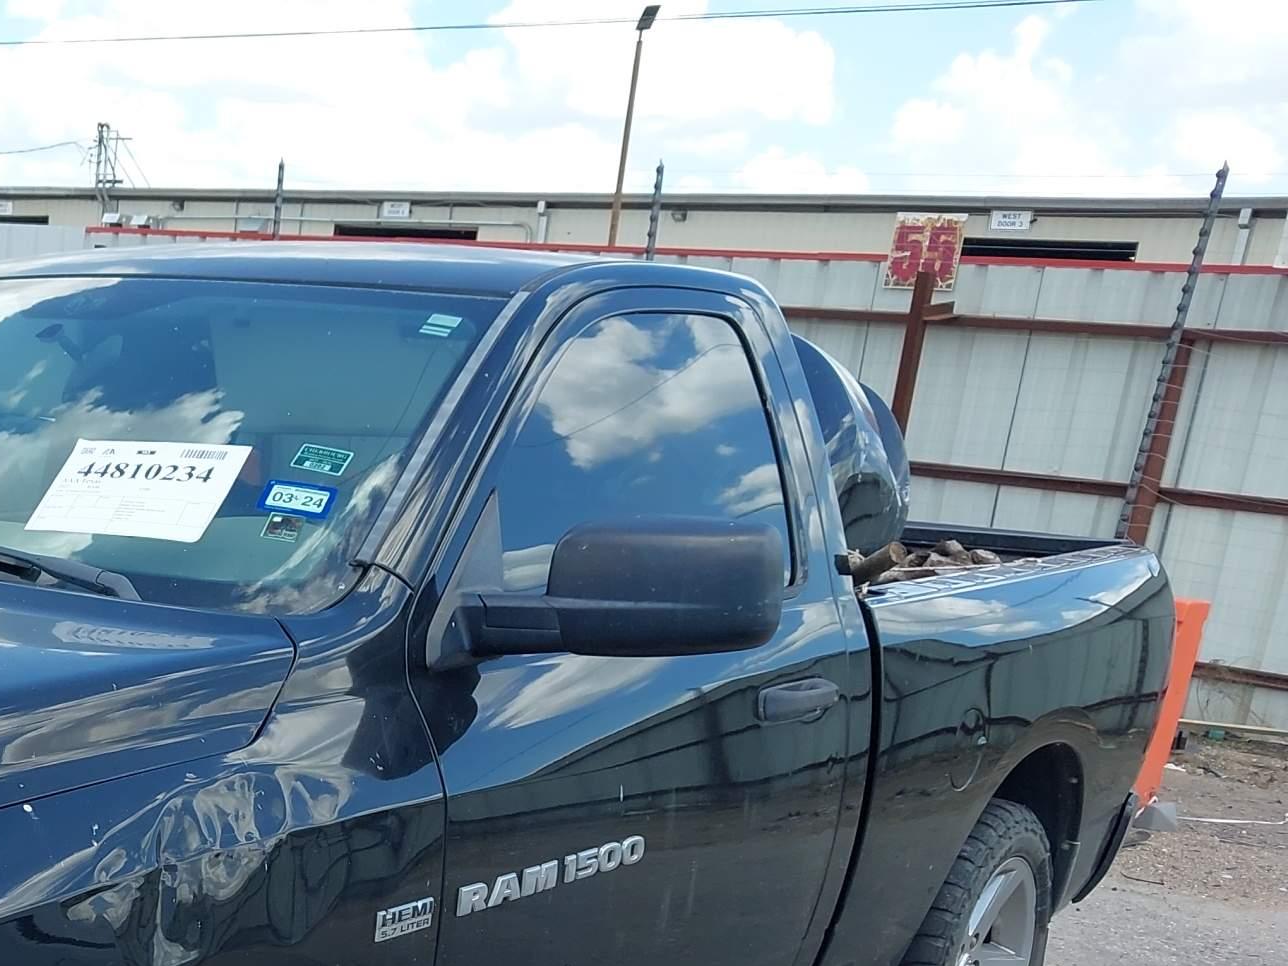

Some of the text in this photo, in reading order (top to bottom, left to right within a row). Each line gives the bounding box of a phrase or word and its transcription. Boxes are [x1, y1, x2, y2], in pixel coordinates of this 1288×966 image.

[1002, 212, 1021, 220] WEST
[76, 460, 215, 484] 44810234
[272, 491, 324, 508] 03 24
[456, 835, 646, 917] RAM 1500
[380, 898, 434, 928] HEMI
[380, 917, 430, 938] 5.7 LITER
